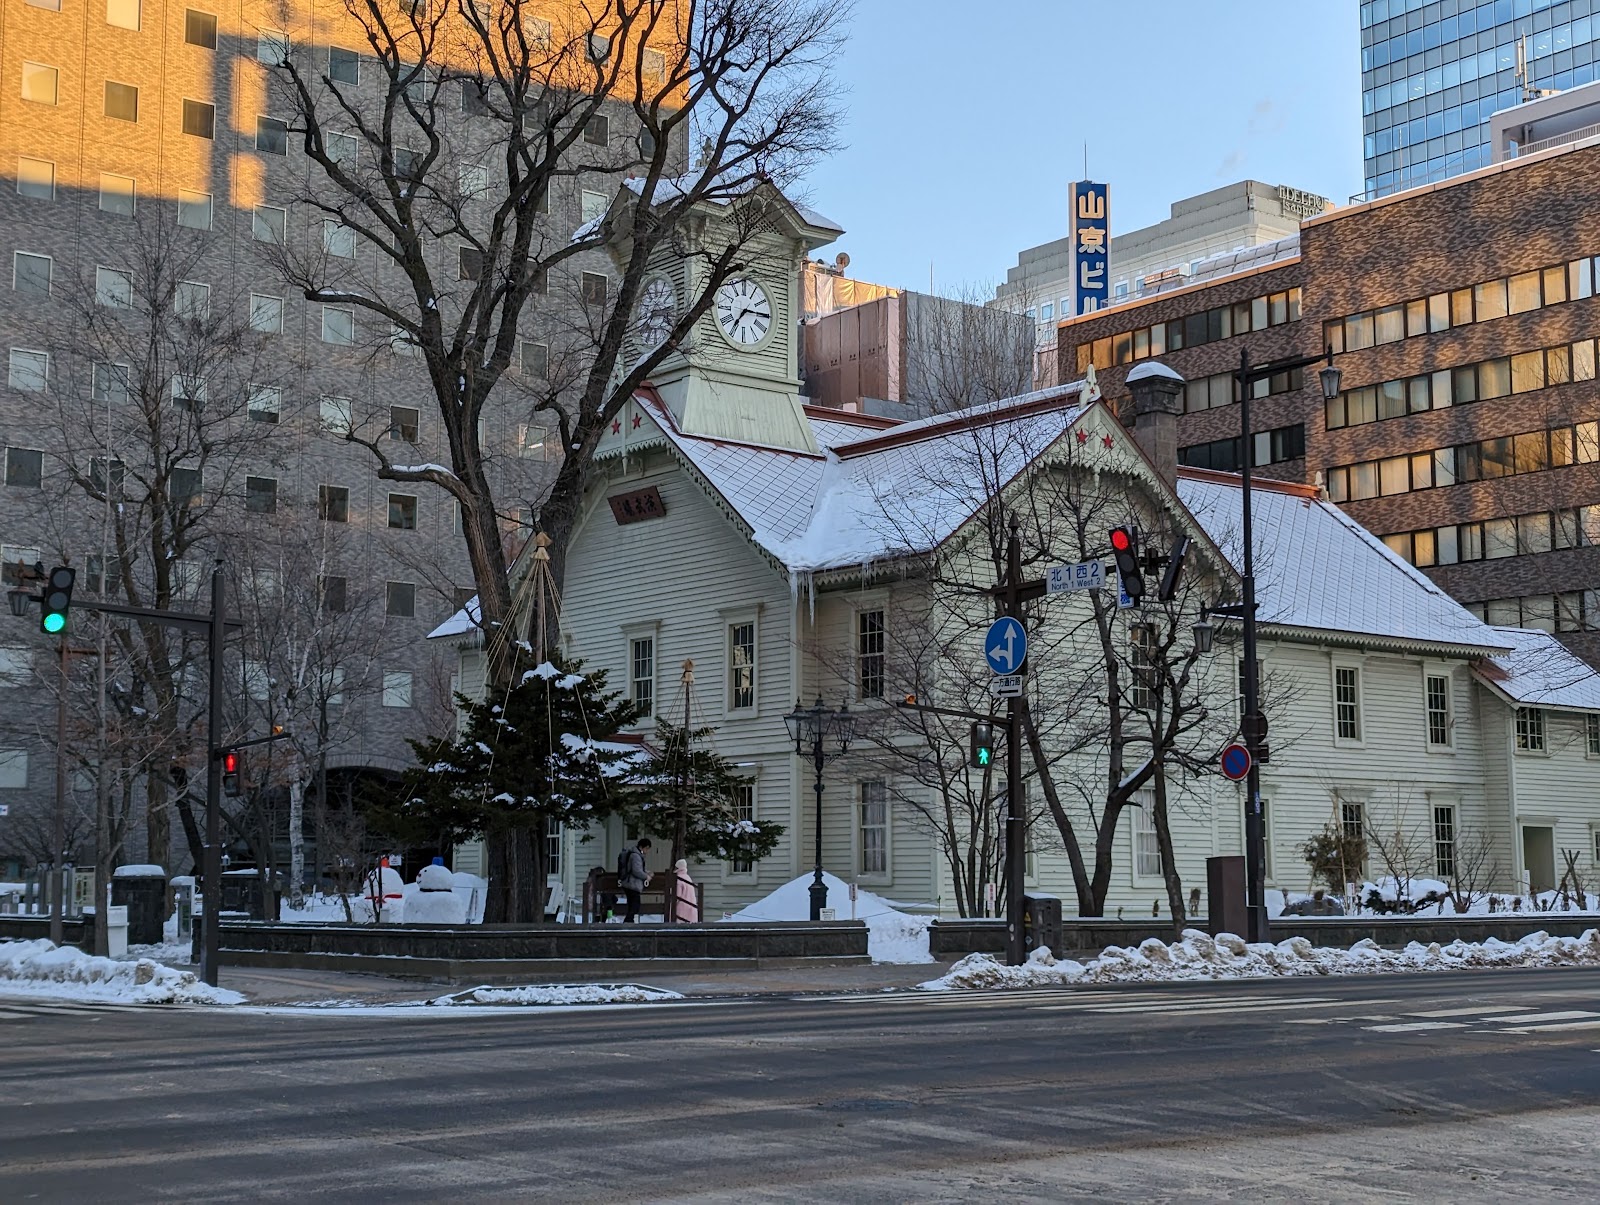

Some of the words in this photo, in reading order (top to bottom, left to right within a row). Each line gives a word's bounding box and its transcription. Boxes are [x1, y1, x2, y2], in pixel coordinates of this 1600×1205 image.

[1078, 190, 1106, 314] 山京ビル
[1051, 562, 1099, 582] 北1西2
[1051, 582, 1069, 591] North
[1077, 578, 1094, 588] West
[1096, 577, 1101, 585] 2
